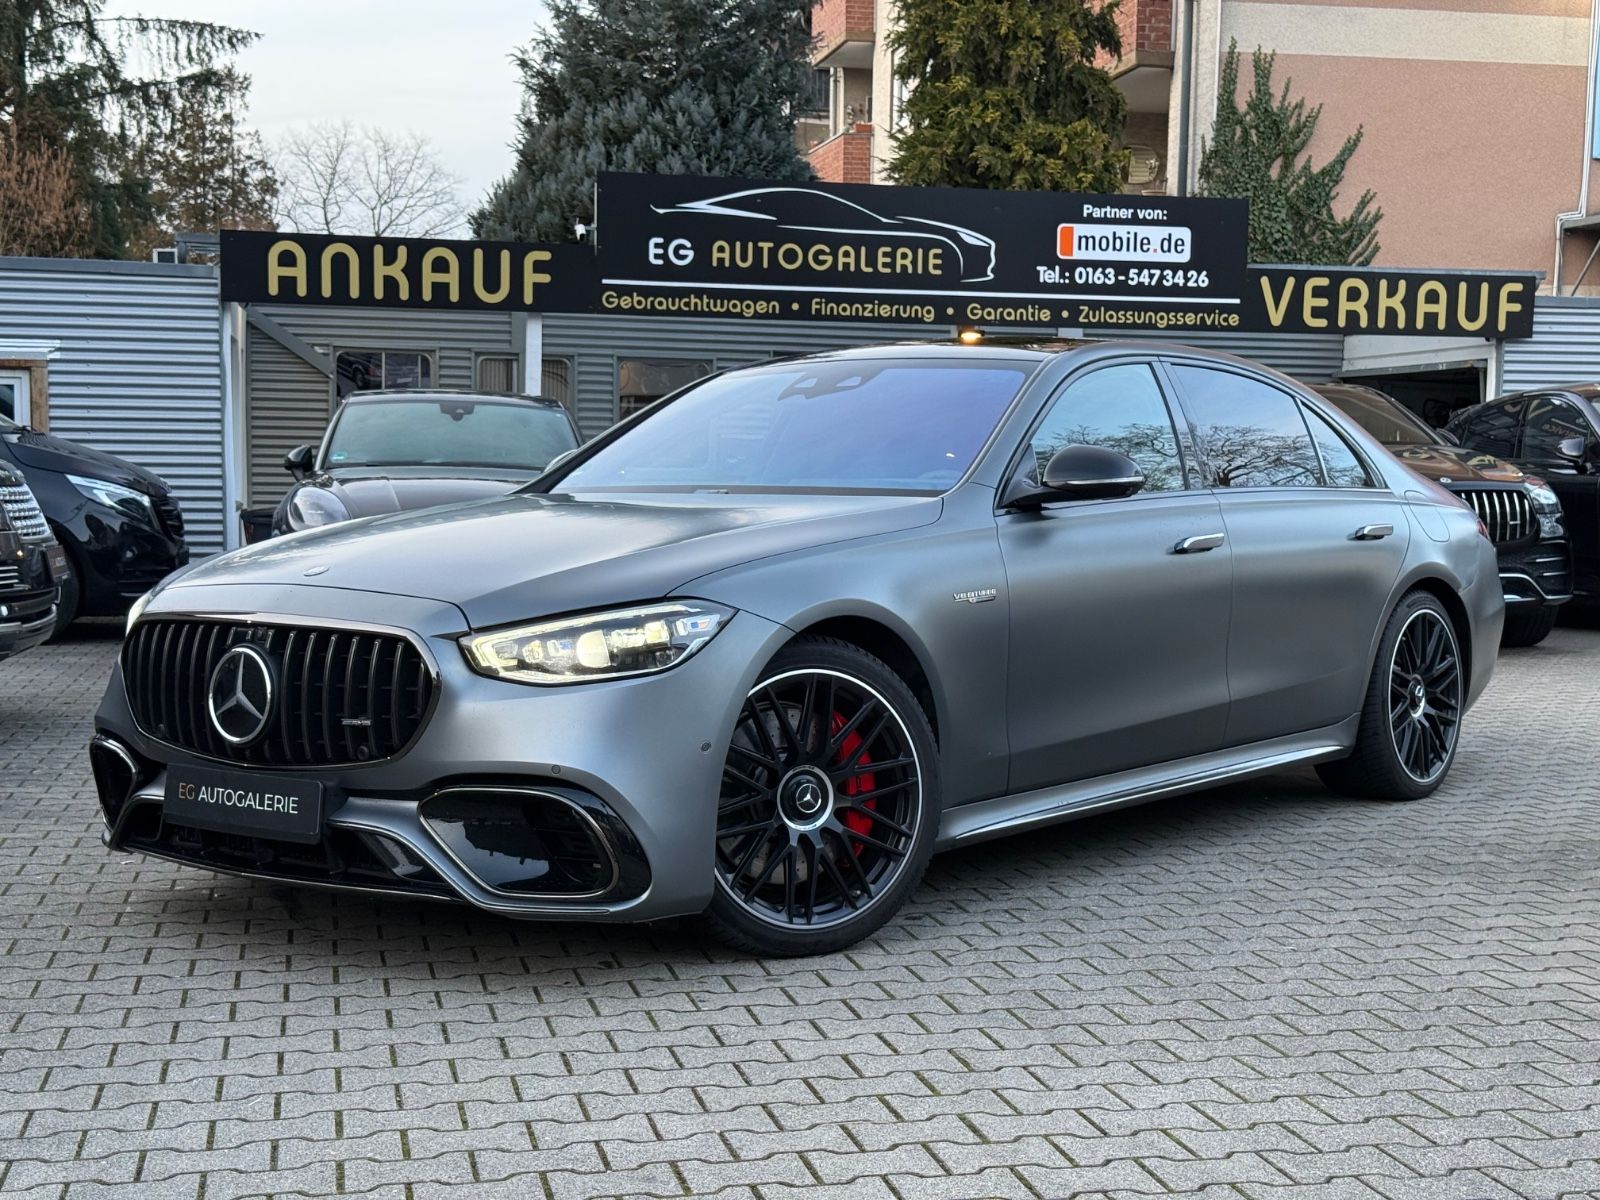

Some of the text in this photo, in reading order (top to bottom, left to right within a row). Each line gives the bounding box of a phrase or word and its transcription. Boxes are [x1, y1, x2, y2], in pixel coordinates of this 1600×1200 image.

[1083, 203, 1168, 221] Partner von:
[648, 236, 943, 275] EG AUTOGALERIE
[1078, 231, 1185, 254] mobile.de
[268, 240, 552, 305] ANKAUF
[1036, 265, 1070, 284] Tel.:
[602, 291, 1240, 329] Gebrauchtwagen Finanzierung Garantie Zulassungsservice
[1260, 275, 1524, 332] VERKAUF
[178, 782, 299, 815] EG AUTOGALERIE
